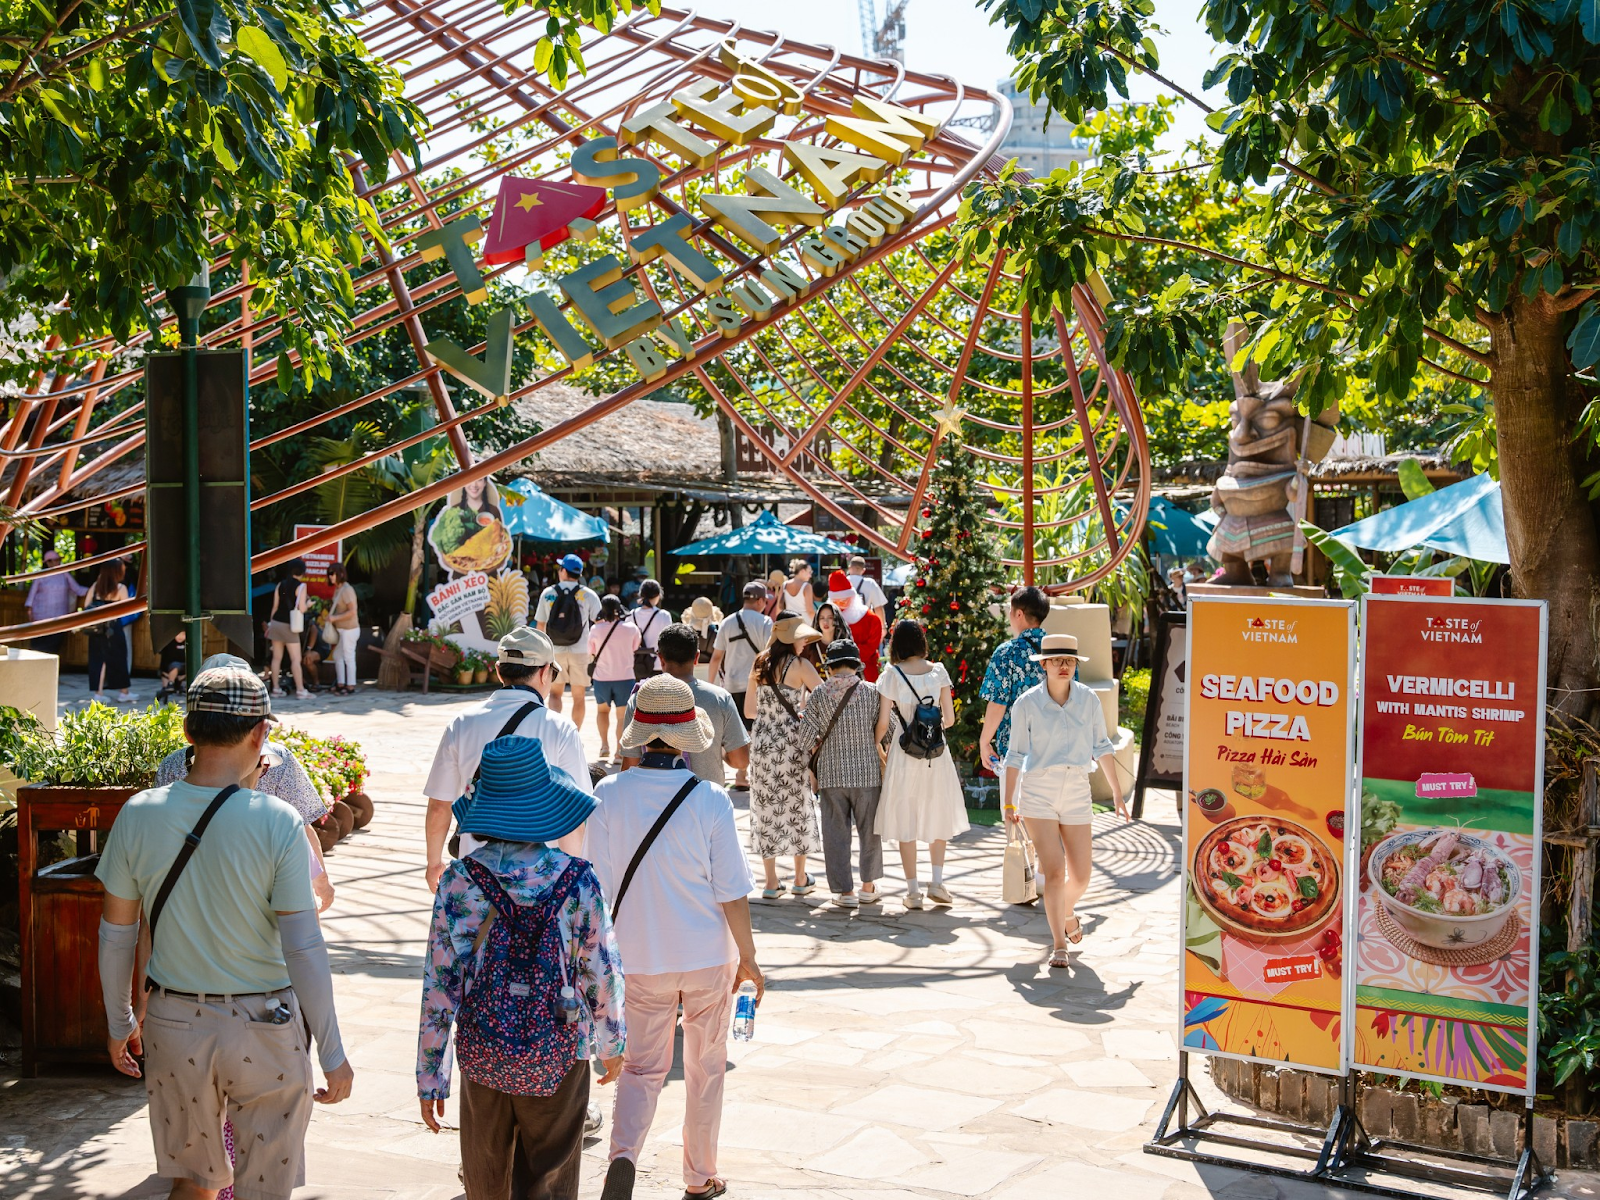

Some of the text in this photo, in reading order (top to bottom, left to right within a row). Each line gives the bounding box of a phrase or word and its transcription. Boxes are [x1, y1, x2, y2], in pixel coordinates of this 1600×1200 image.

[719, 36, 805, 116] of
[425, 95, 941, 407] VIETNAM
[625, 185, 919, 384] BY SUN GROUP
[431, 574, 486, 607] BÁNH XÈO
[463, 590, 476, 599] NAM
[1247, 617, 1298, 633] TASTE of
[1426, 616, 1482, 633] TASTE of
[1242, 631, 1298, 644] VIETNAM
[1420, 630, 1482, 644] VIETNAM
[1200, 674, 1339, 707] SEAFOOD
[1386, 674, 1515, 700] VERMICELLI
[1376, 701, 1525, 722] WITH MANTIS SHRIMP
[1225, 711, 1311, 742] PIZZA
[1402, 724, 1495, 746] Bún Tôm Tít
[1217, 745, 1318, 768] Pizza Hải Sản
[1421, 777, 1475, 791] MUST TRY!
[1266, 959, 1319, 978] MUST TRY!
